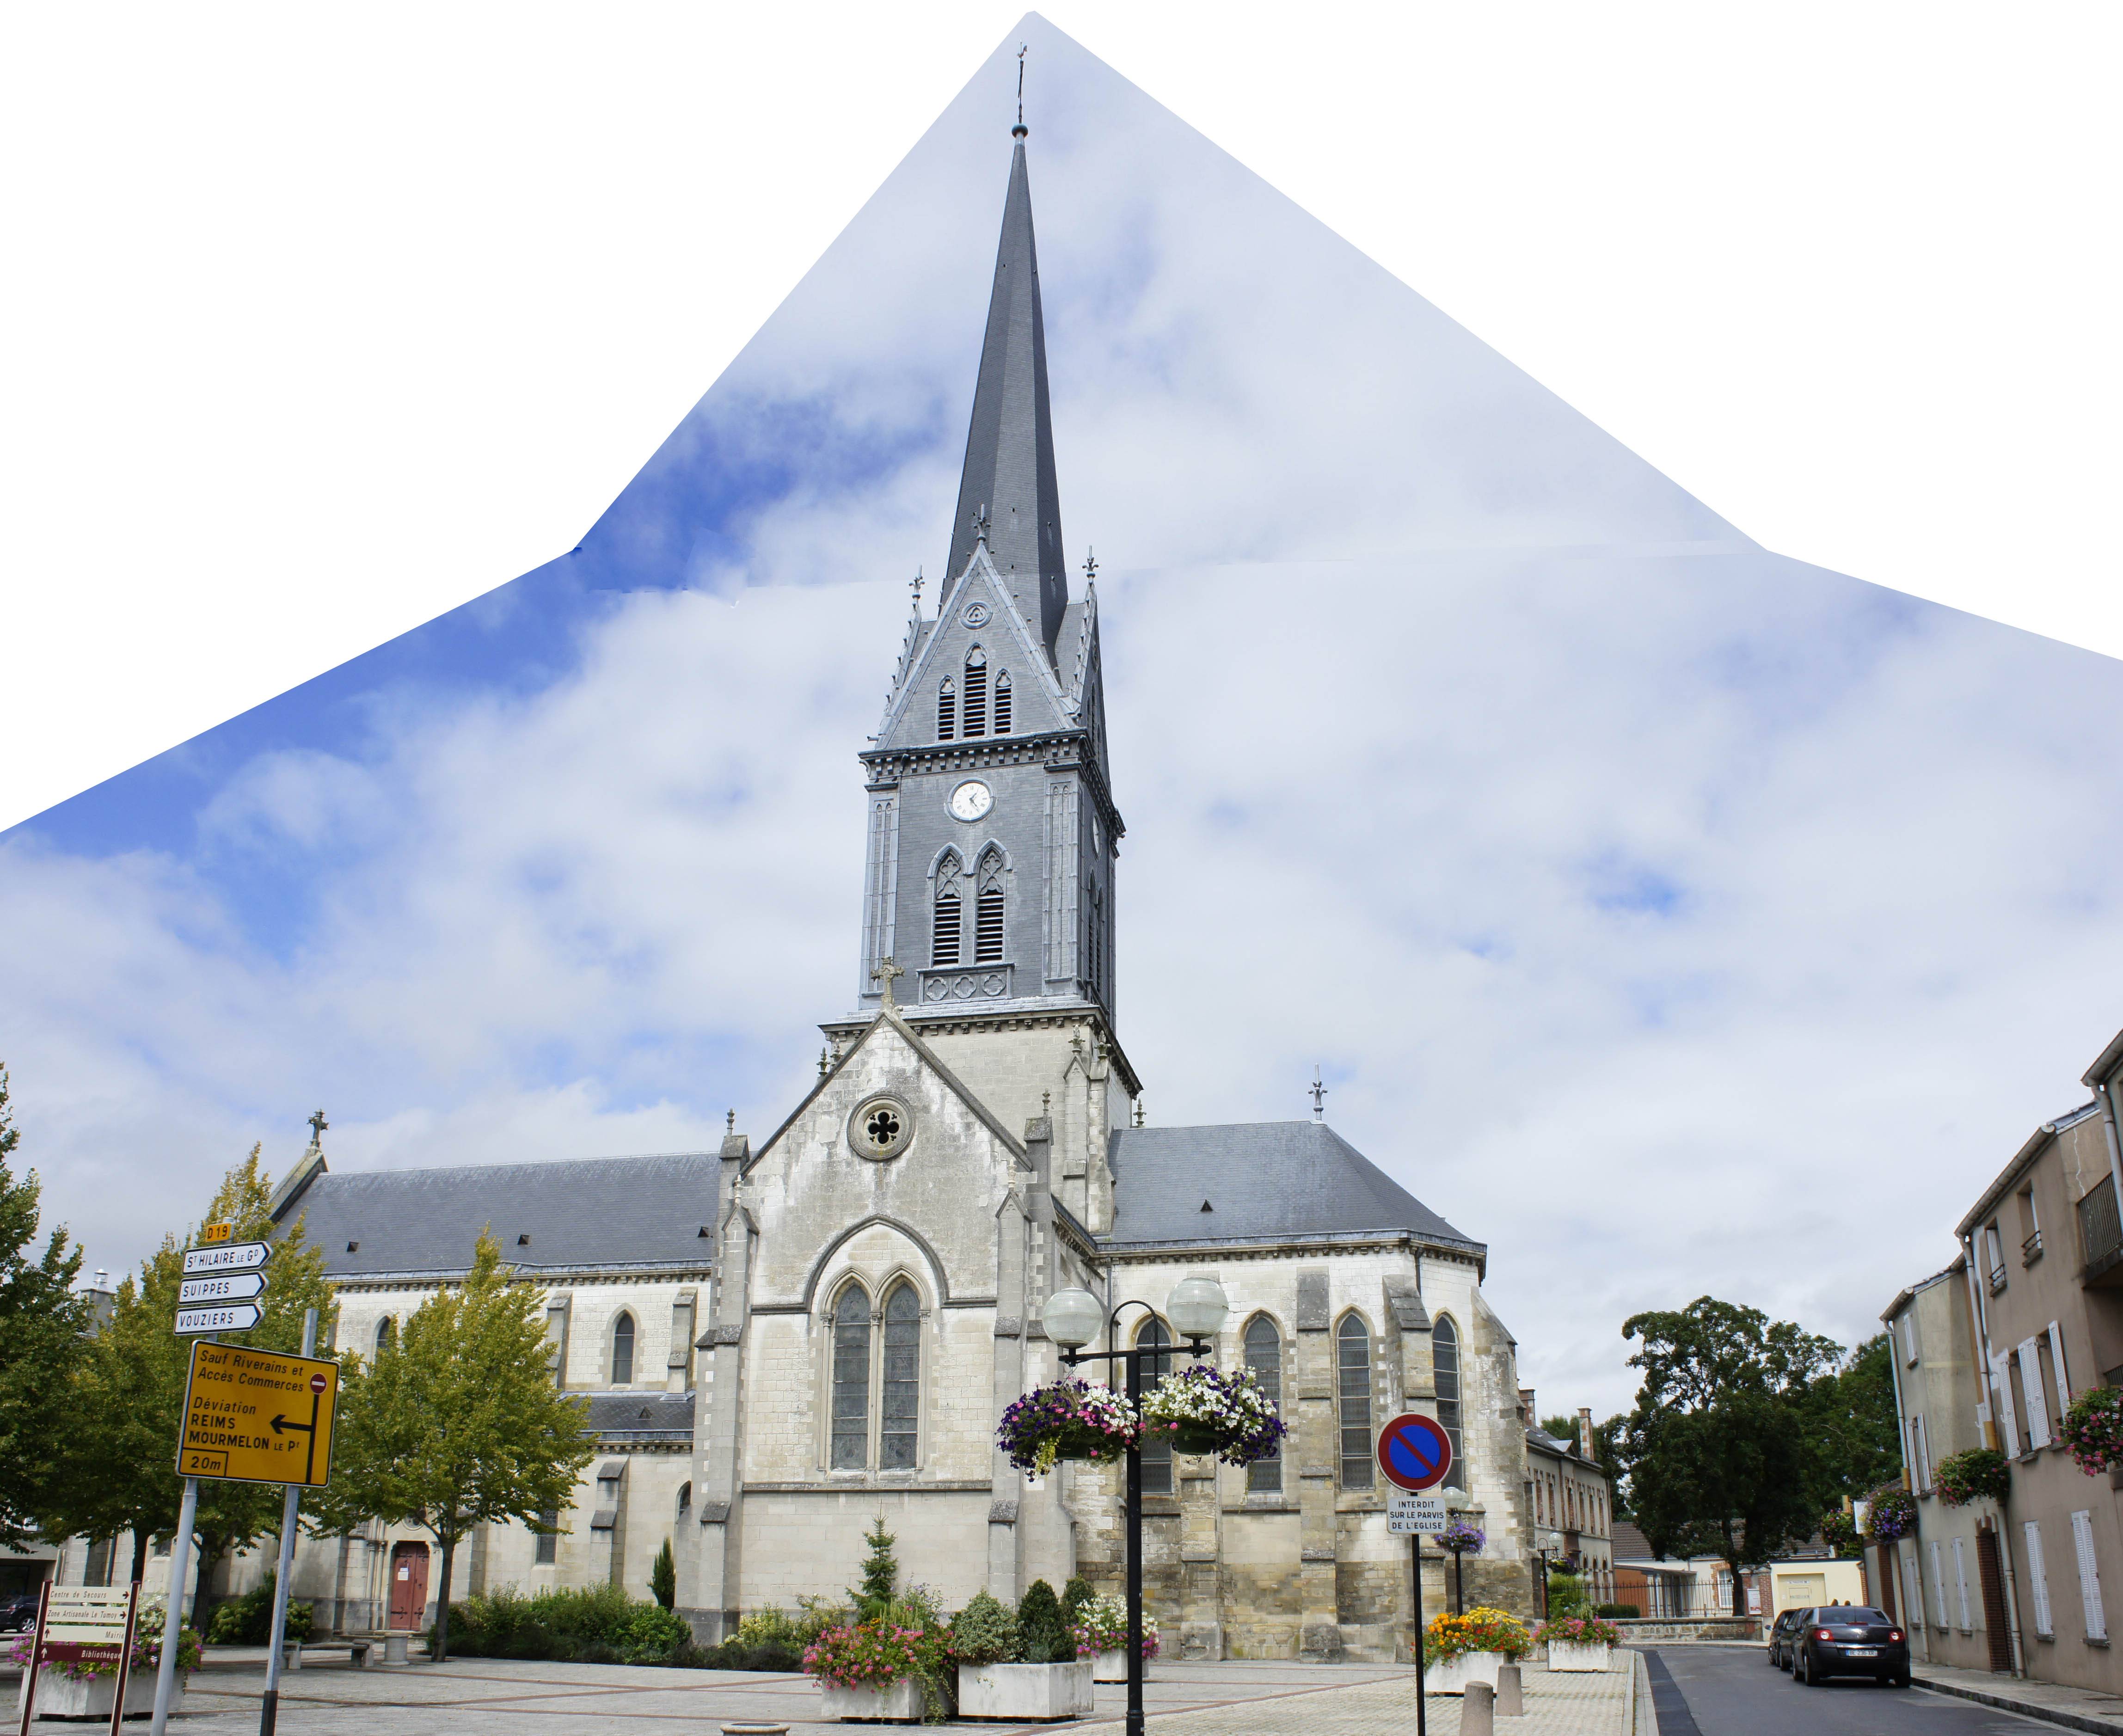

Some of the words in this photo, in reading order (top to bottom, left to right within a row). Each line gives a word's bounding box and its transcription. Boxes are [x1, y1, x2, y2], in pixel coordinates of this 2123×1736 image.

[207, 1228, 213, 1239] D
[216, 1226, 228, 1238] 19
[199, 1252, 235, 1266] HILAIRE
[183, 1282, 230, 1297] SUIPPES
[180, 1313, 234, 1327] VOUZIERS
[200, 1350, 228, 1364] Sauf
[233, 1355, 288, 1374] Riverains
[292, 1366, 304, 1376] et
[239, 1373, 304, 1392] Commerces
[193, 1397, 257, 1415] Déviation
[191, 1414, 235, 1429] REIMS
[189, 1431, 270, 1449] MOURMELON
